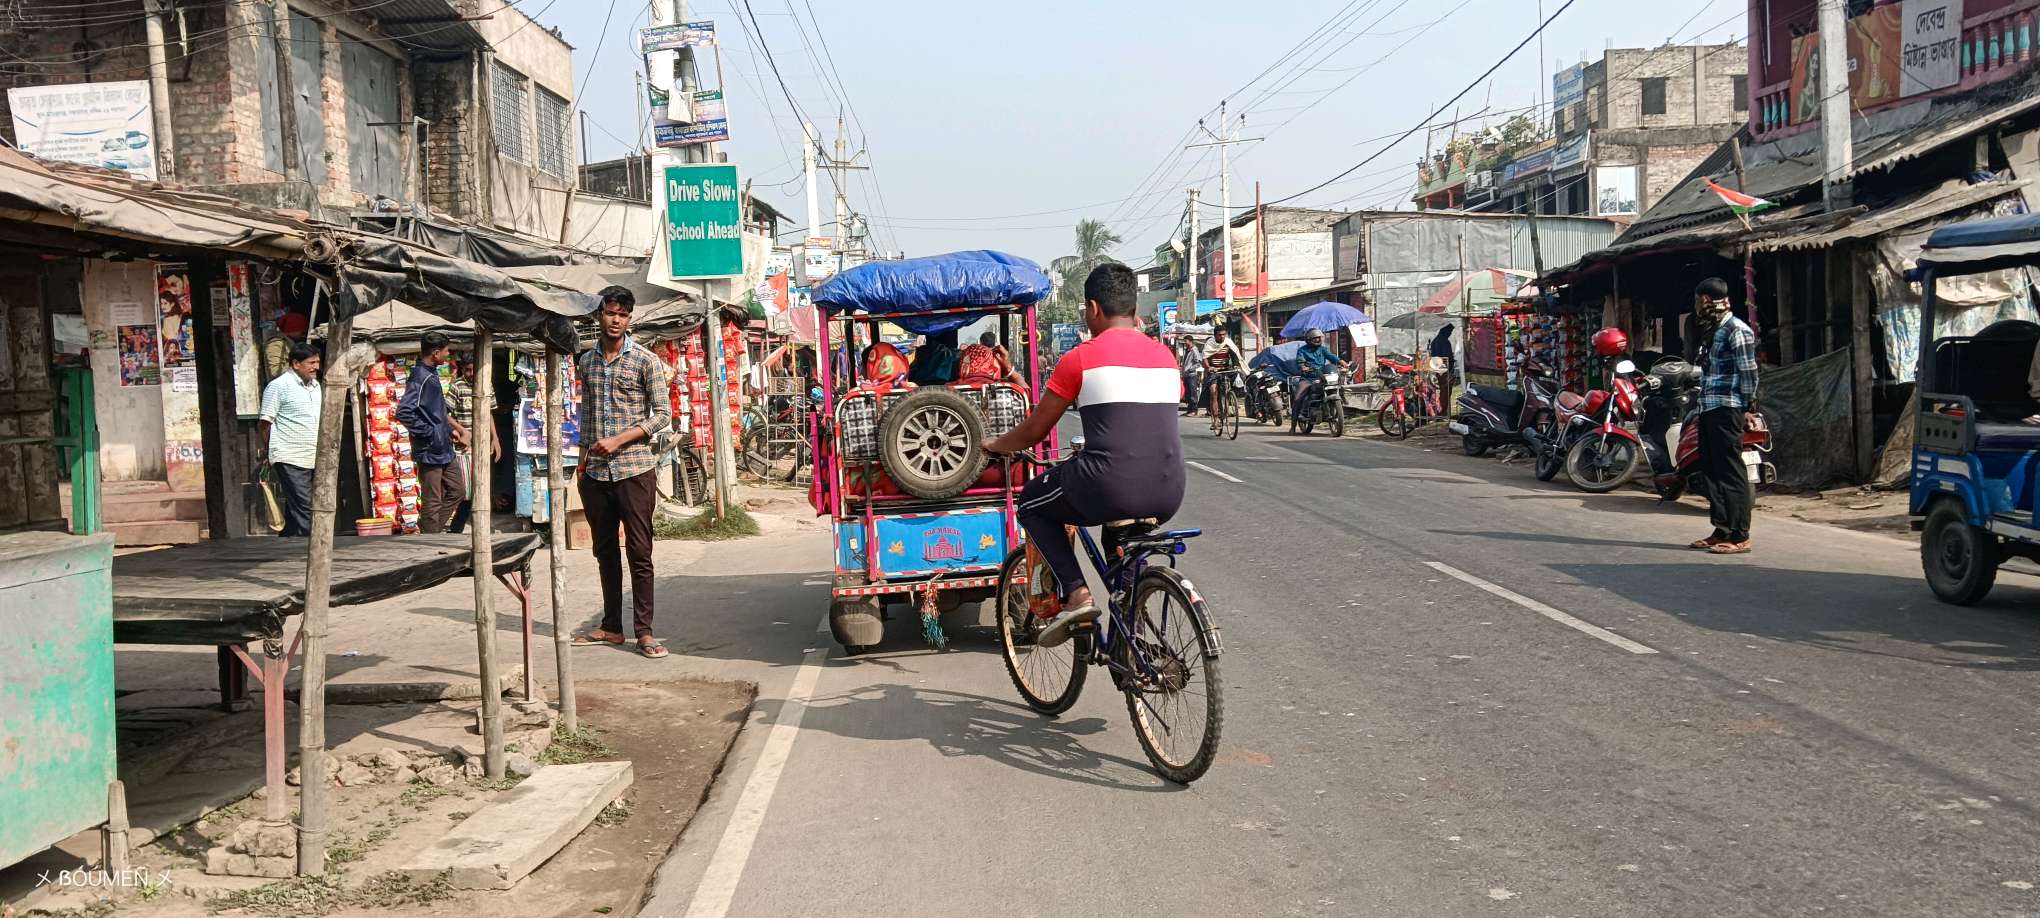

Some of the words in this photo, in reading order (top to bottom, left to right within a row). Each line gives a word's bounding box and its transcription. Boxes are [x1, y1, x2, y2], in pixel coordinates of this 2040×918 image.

[669, 179, 700, 202] Drive
[669, 220, 705, 241] School
[707, 220, 740, 240] Ahead
